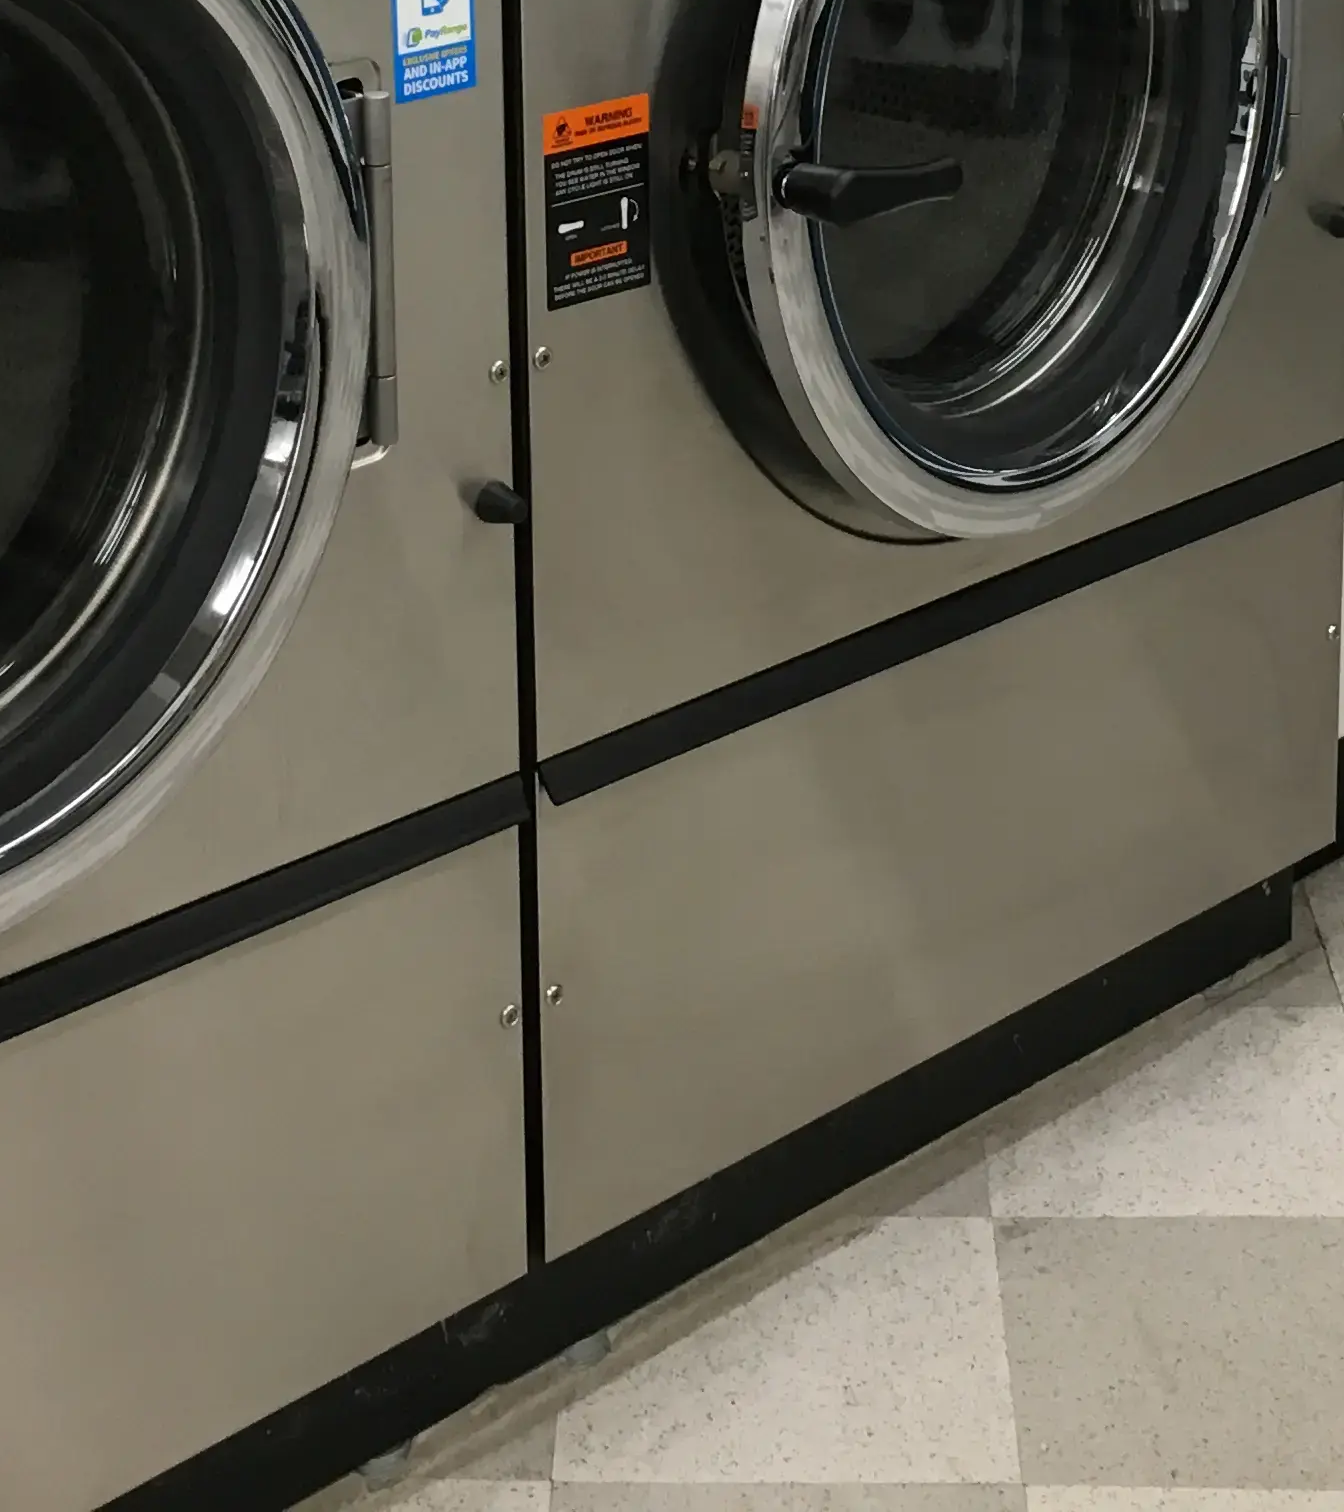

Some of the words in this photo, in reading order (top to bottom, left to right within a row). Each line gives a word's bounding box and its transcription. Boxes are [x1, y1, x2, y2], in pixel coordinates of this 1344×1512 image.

[425, 24, 467, 39] PayRange
[404, 64, 427, 80] AND
[430, 56, 467, 74] IN-APP
[403, 70, 469, 96] DISCOUNTS
[584, 107, 633, 126] WARNING
